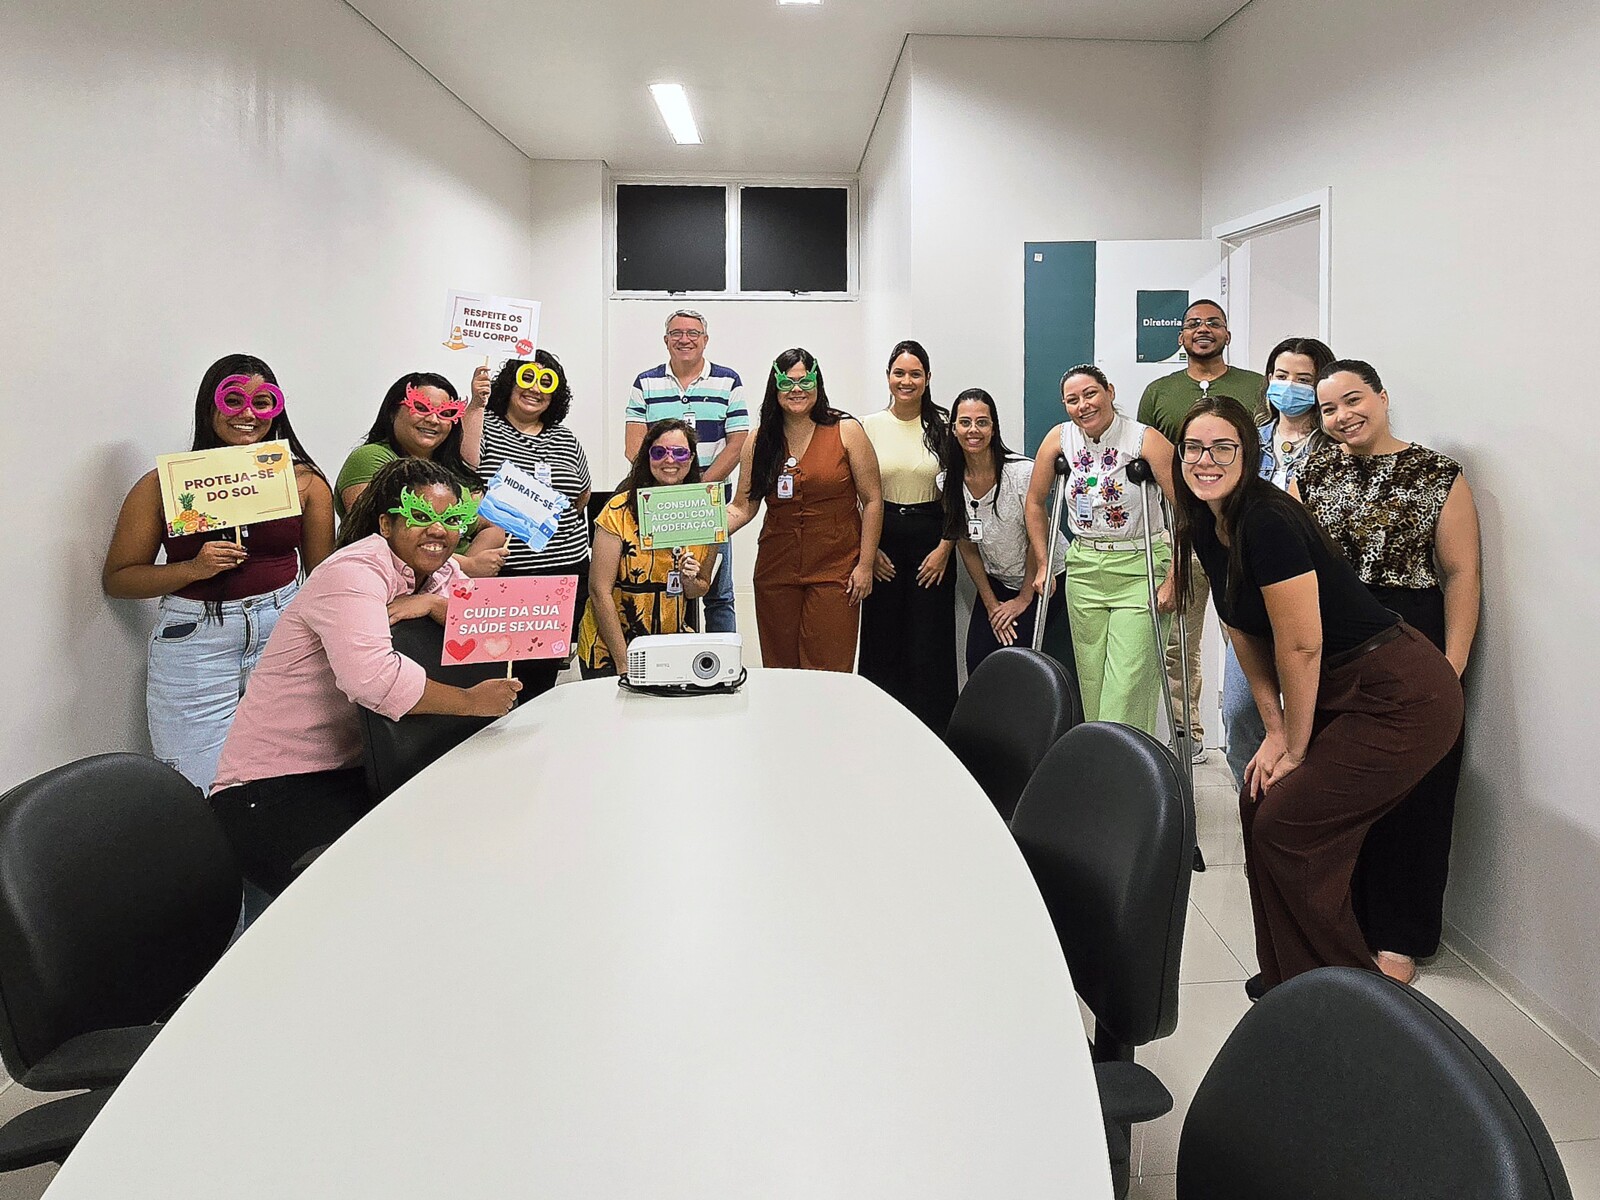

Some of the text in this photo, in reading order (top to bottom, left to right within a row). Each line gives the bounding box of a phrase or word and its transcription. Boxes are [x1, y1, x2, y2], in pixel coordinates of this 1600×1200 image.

[463, 307, 523, 323] RESPEITE OS
[1143, 318, 1182, 326] Diretoria
[464, 318, 518, 333] LIMITES DO
[462, 329, 518, 343] SEU CORPO
[184, 468, 275, 491] PROTEJA-SE
[206, 485, 259, 502] DO SOL
[503, 475, 554, 511] HIDRATE-SE
[656, 499, 707, 510] CONSUMA
[691, 508, 715, 518] COM
[463, 605, 560, 619] CUIDE DA SUA
[459, 618, 560, 635] SAÚDE SEXUAL
